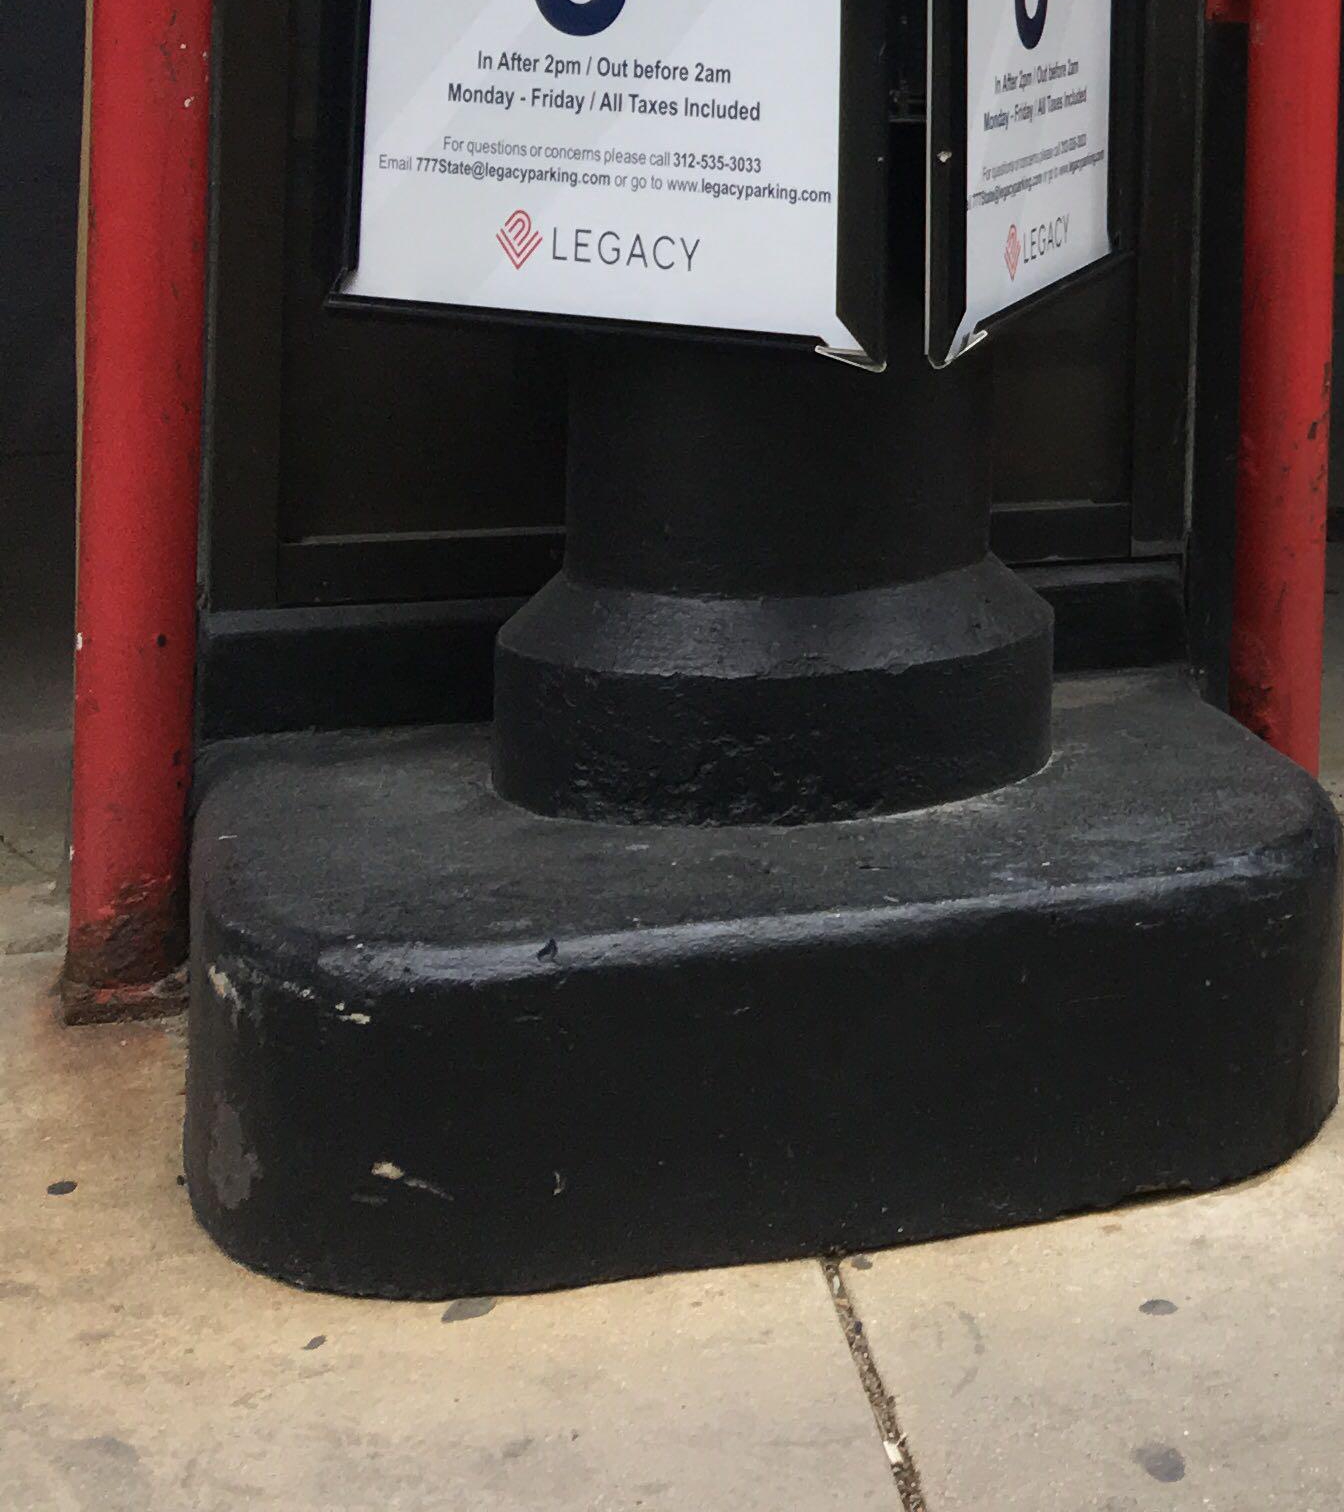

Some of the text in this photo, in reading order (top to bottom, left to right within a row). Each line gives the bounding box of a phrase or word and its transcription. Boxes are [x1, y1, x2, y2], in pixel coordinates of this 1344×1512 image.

[478, 50, 493, 71] In
[497, 51, 540, 73] After
[544, 54, 581, 79] 2pm
[597, 56, 628, 78] Out
[633, 59, 689, 82] before
[694, 62, 732, 84] 2am
[448, 83, 515, 110] Monday
[531, 88, 586, 115] Friday
[600, 92, 623, 113] All
[628, 94, 679, 116] Taxes
[684, 97, 761, 121] Included
[443, 136, 762, 174] For questions or concerns please call 312-535-3033
[379, 154, 832, 205] Email 777State@legacyparking.com or go to www.legacyparking.com
[552, 226, 700, 272] LEGACY
[1023, 214, 1070, 263] LEGACY
